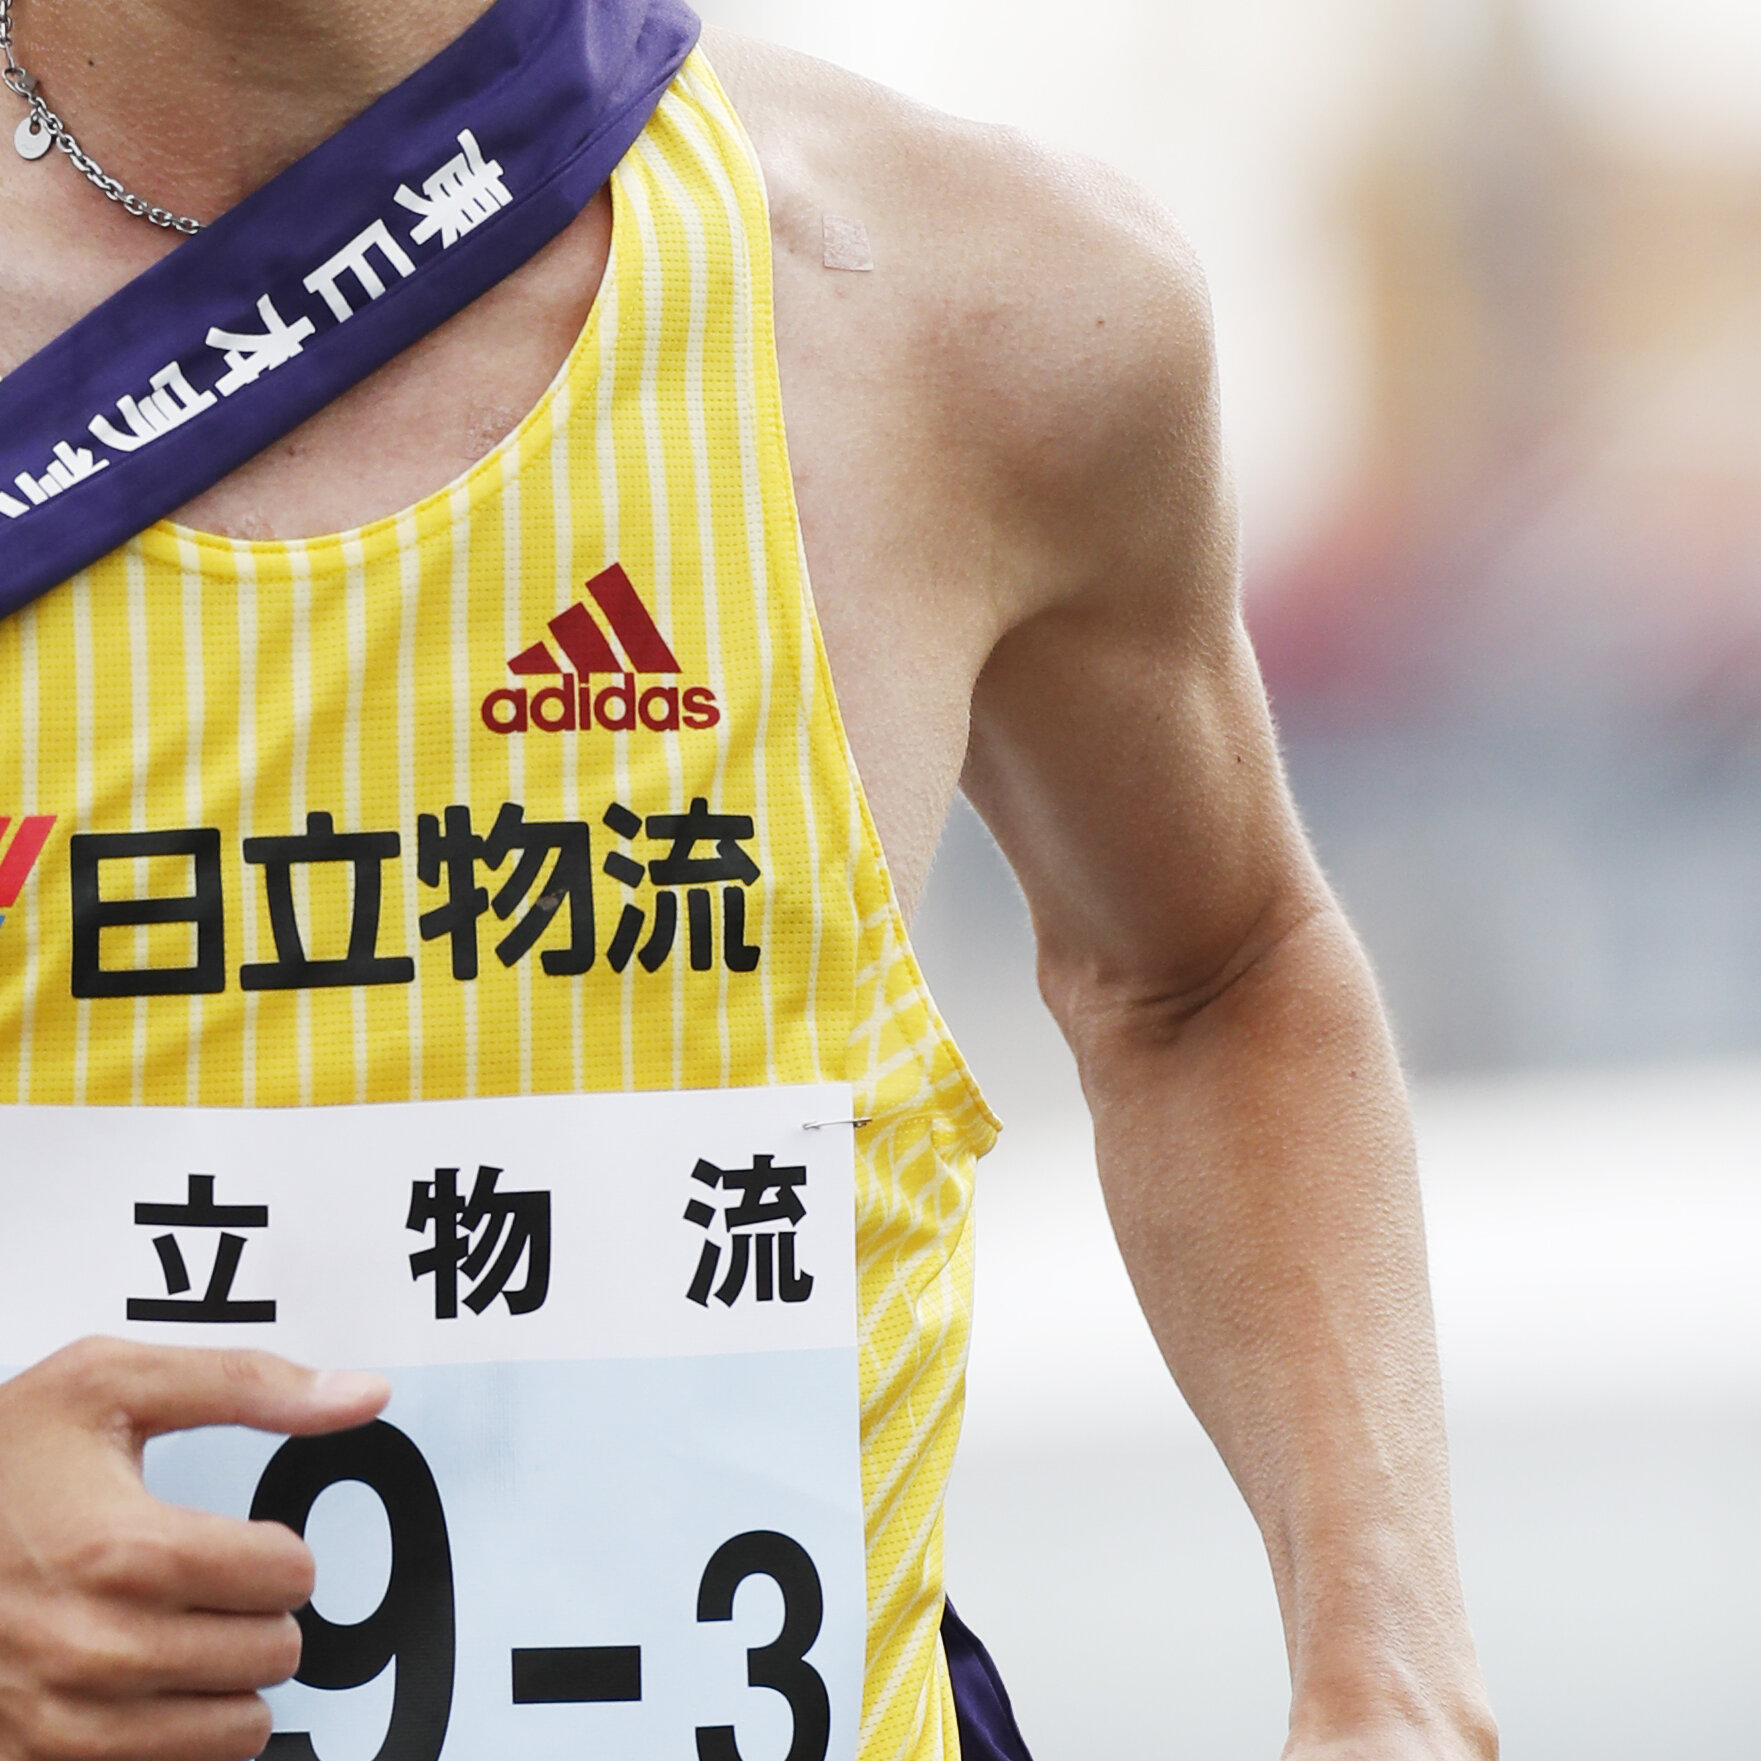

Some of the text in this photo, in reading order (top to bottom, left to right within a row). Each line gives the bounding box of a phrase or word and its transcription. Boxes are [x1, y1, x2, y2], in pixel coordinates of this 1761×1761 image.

[480, 671, 721, 735] adidas
[70, 796, 761, 999] 日立物流
